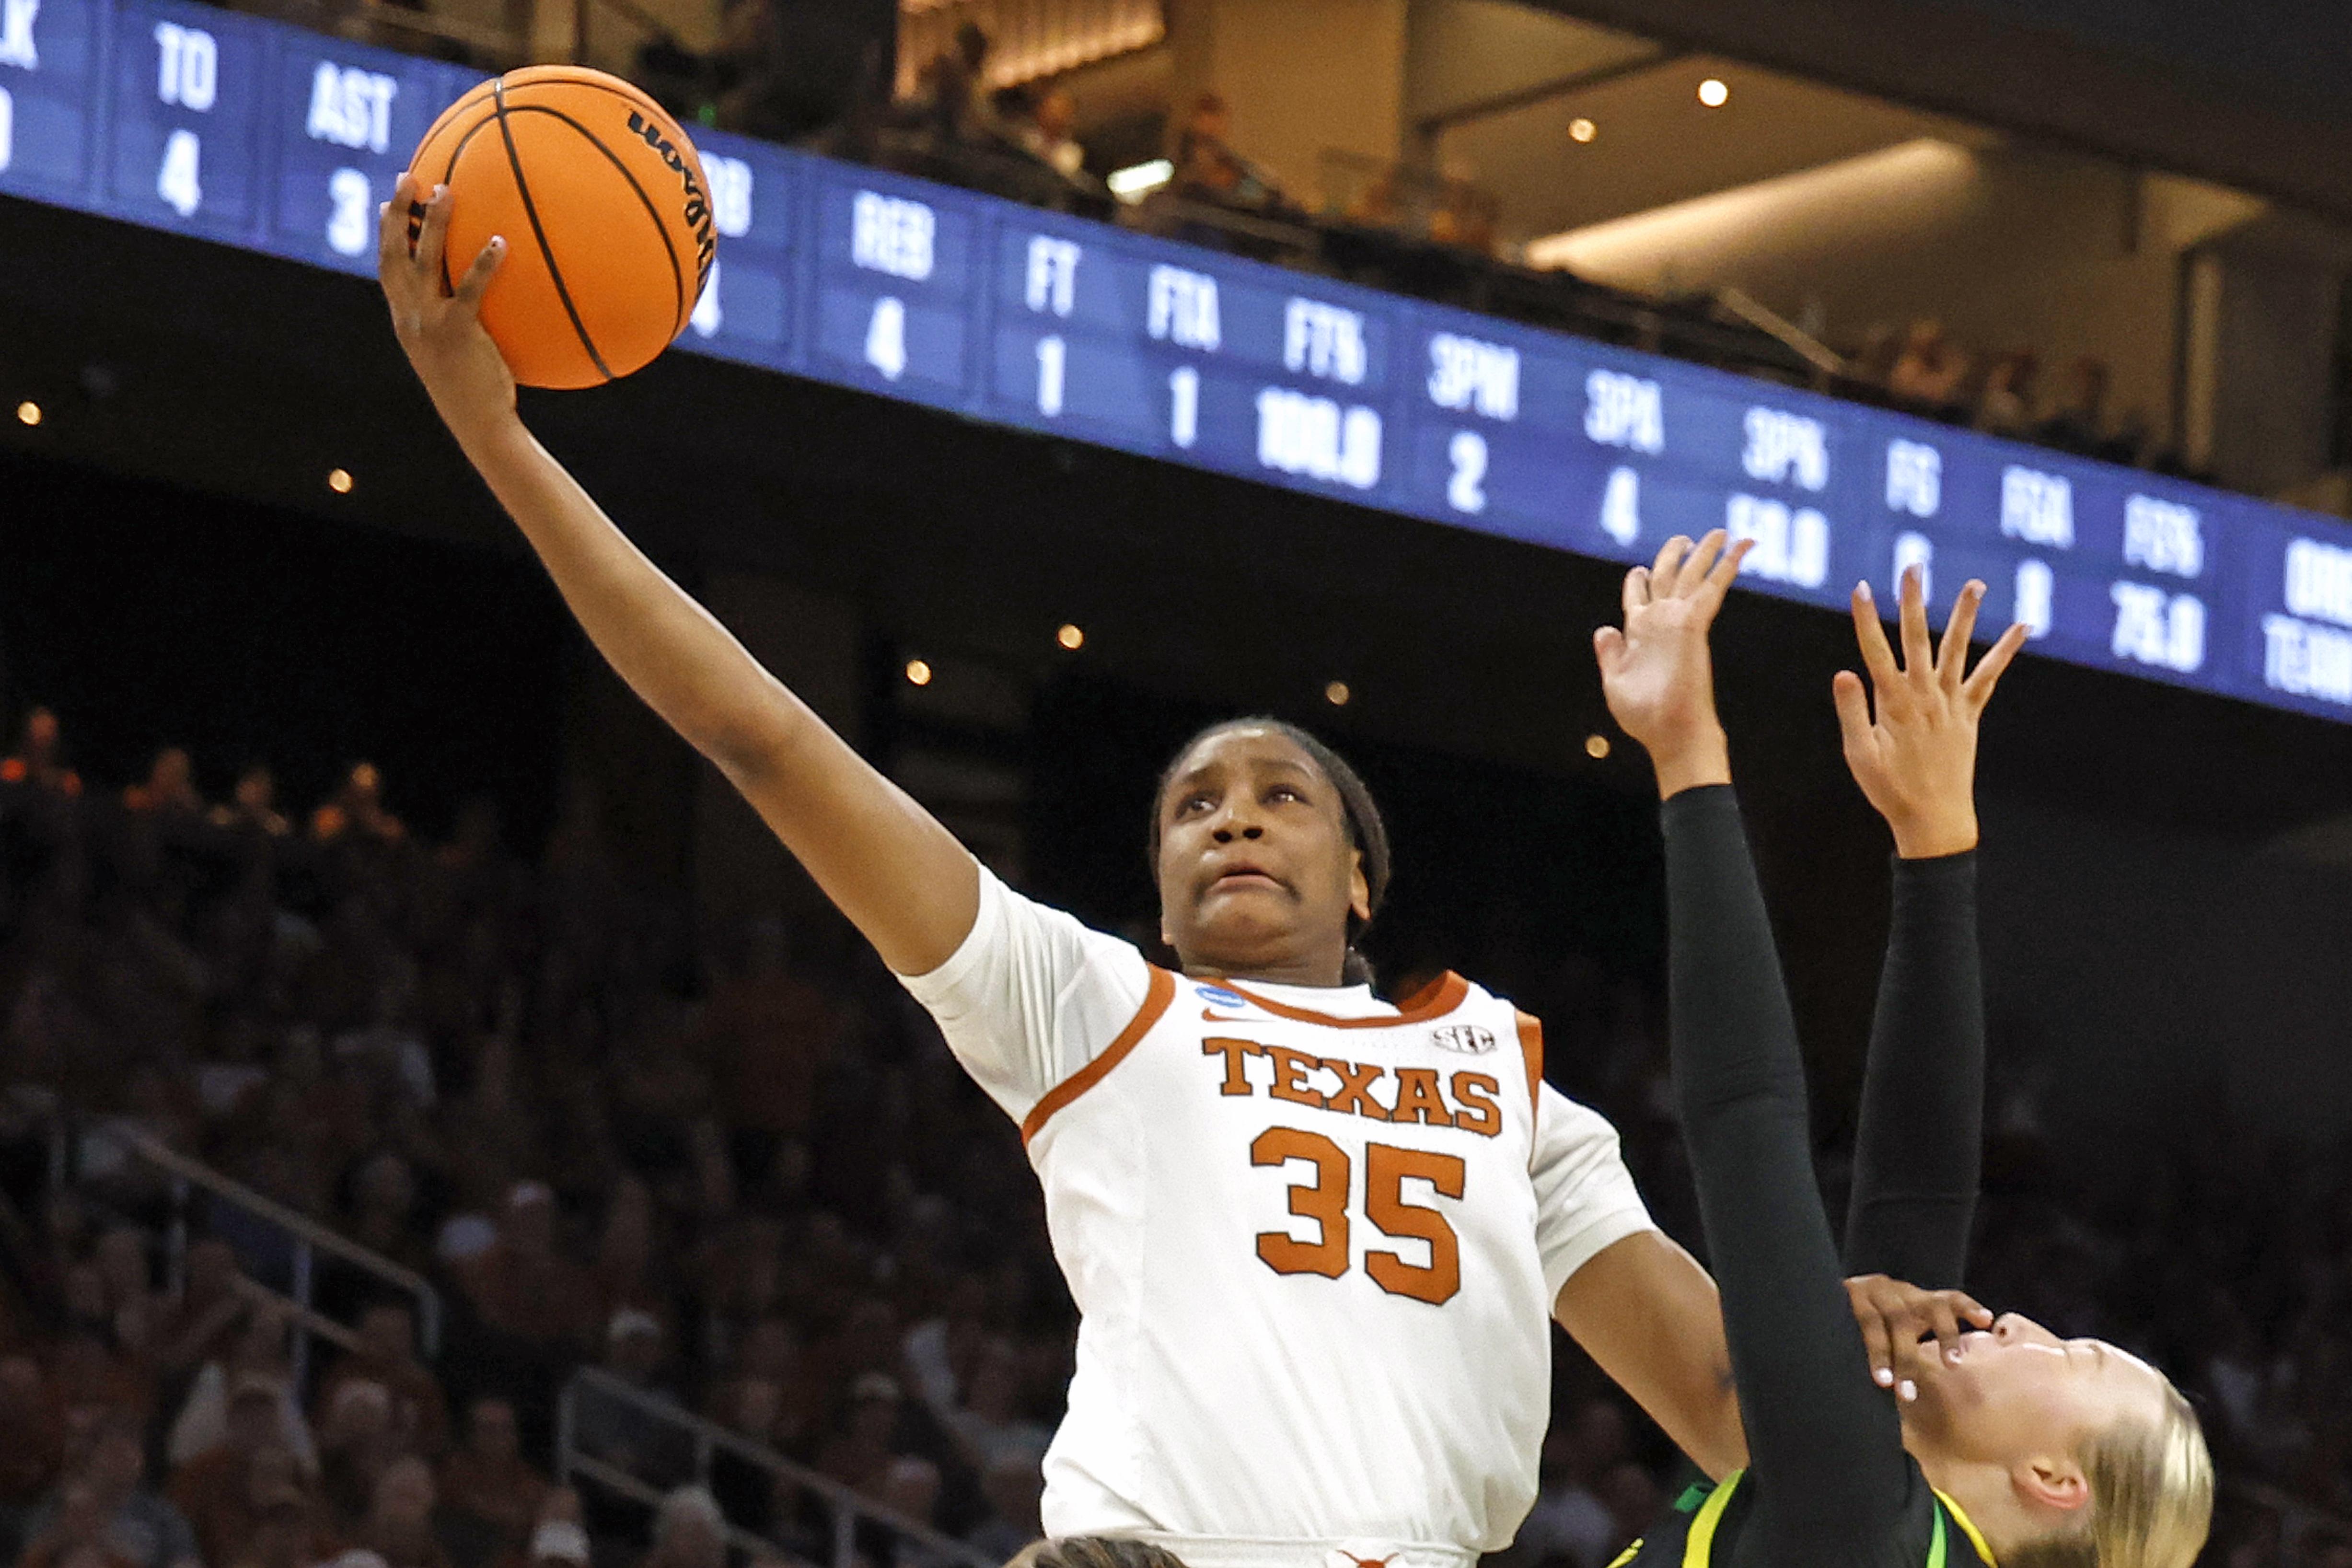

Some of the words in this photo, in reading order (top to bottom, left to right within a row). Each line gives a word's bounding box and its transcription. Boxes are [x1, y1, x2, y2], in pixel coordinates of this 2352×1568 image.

[157, 23, 216, 110] TO
[308, 62, 395, 151] AST
[854, 192, 935, 280] REB
[1026, 236, 1080, 314] FT
[1148, 265, 1220, 349] FTA
[1285, 298, 1366, 384] FT%
[1428, 334, 1520, 420] 3PM
[1585, 370, 1664, 453] 3PA
[1742, 407, 1828, 490] 3P%
[1886, 440, 1941, 517] FG
[159, 130, 201, 215] 4
[327, 169, 371, 256] 3
[866, 297, 907, 381] 4
[1037, 337, 1066, 416] 1
[1170, 367, 1198, 447] 1
[1448, 432, 1487, 513] 2
[1601, 466, 1639, 545] 4
[1202, 1036, 1502, 1138] TEXAS
[1430, 1024, 1497, 1056] SEC
[1250, 1126, 1465, 1307] 35
